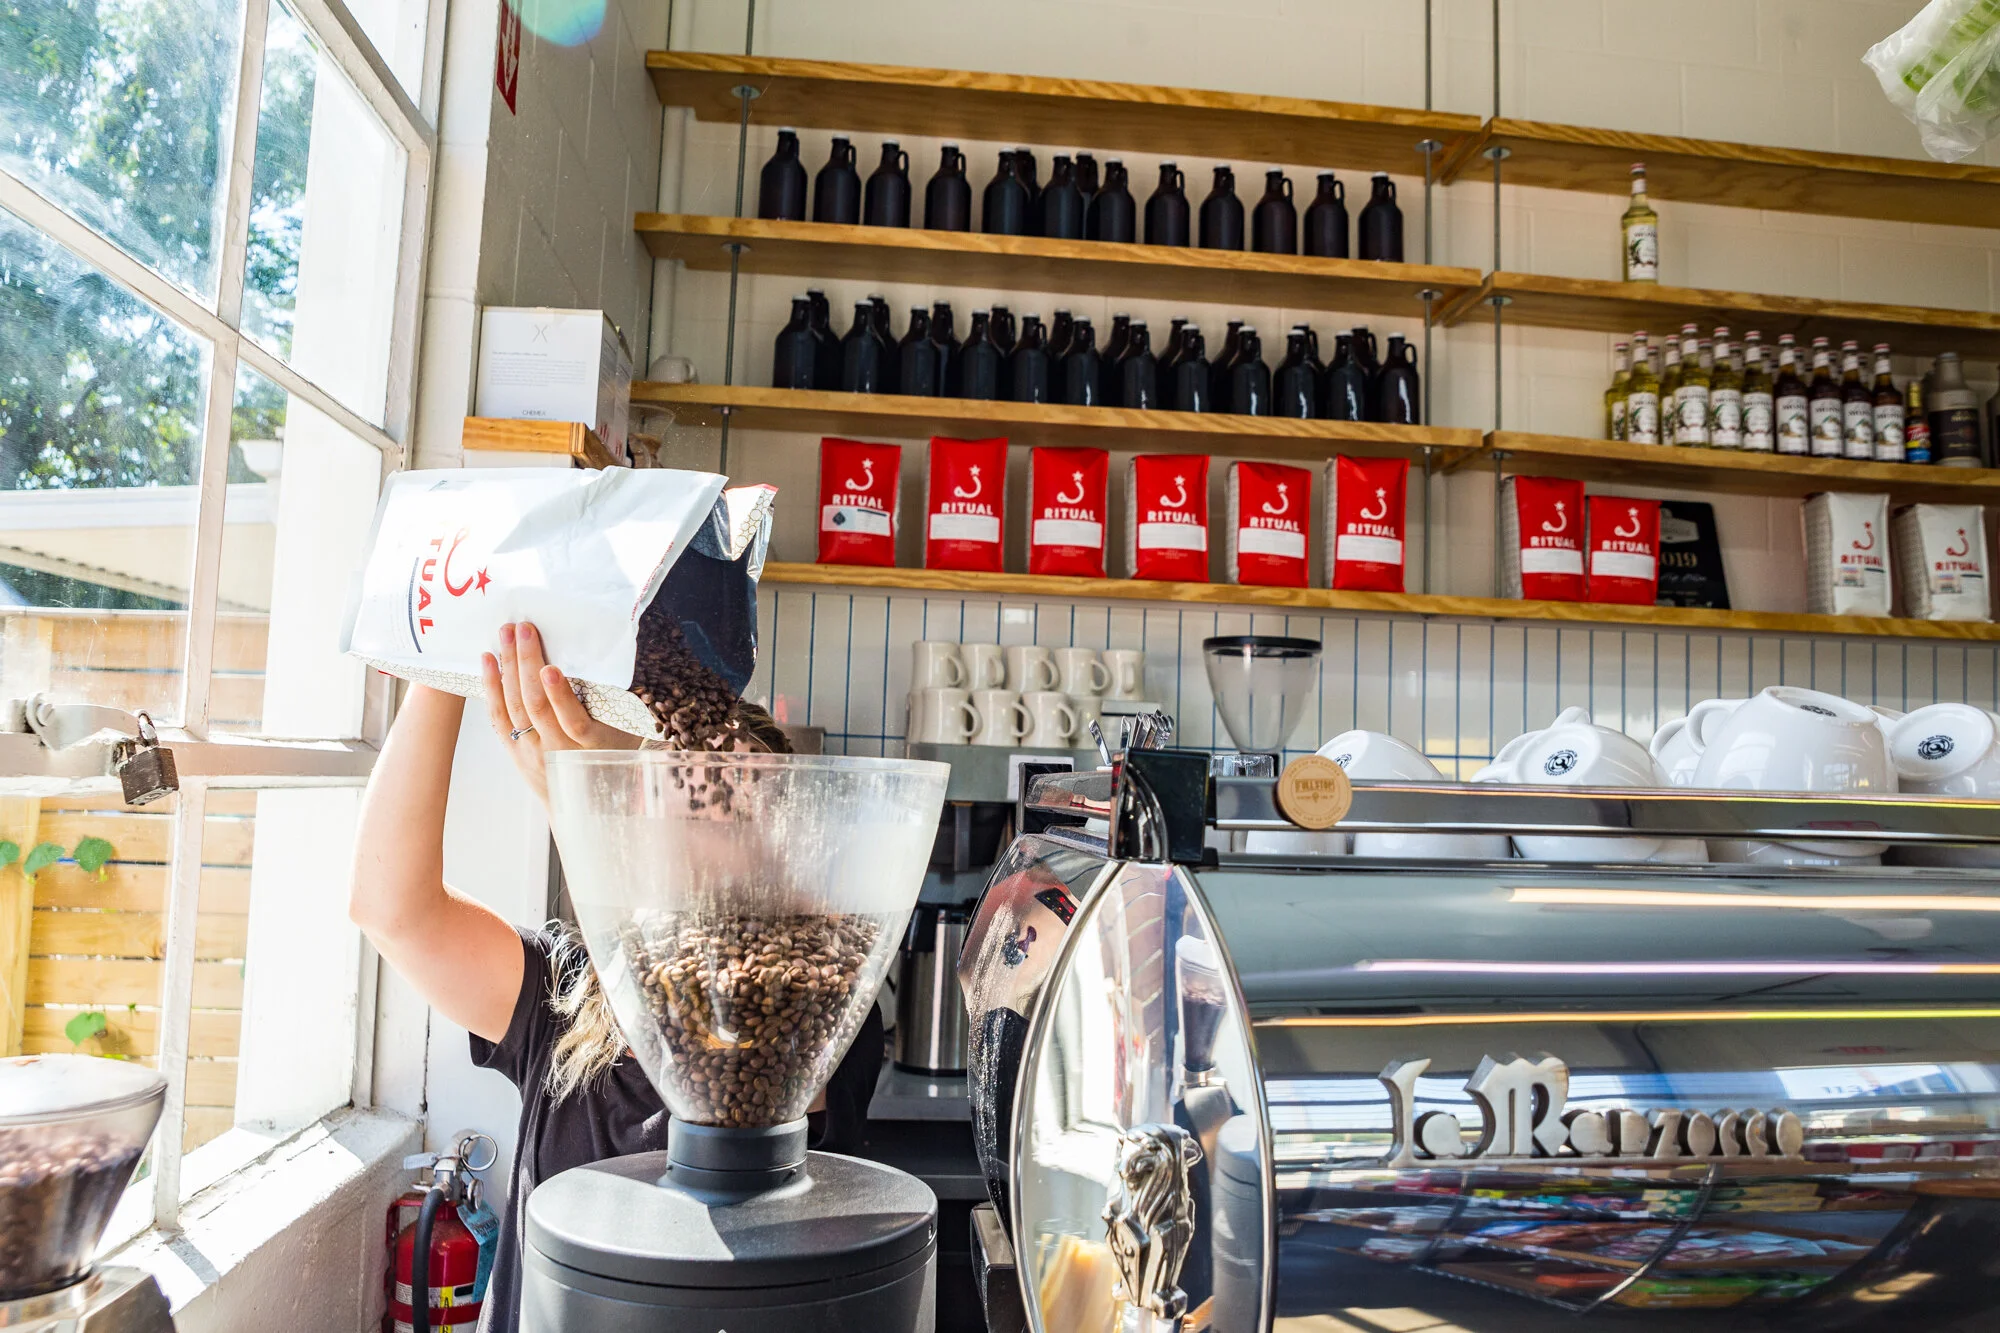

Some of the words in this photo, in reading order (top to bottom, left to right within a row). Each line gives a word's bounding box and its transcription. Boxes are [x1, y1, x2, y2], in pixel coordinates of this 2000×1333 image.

[831, 493, 884, 509] RITUAL
[941, 501, 994, 516] RITUAL
[1044, 507, 1096, 521] RITUAL
[1147, 510, 1198, 525] RITUAL
[1249, 516, 1300, 532] RITUAL
[1347, 522, 1396, 537] RITUAL
[1530, 535, 1576, 549] RITUAL
[1601, 539, 1652, 554] RITUAL
[1658, 551, 1698, 568] 019
[1840, 553, 1884, 567] RITUAL
[1934, 561, 1982, 573] RITUAL
[418, 535, 444, 635] TUAL
